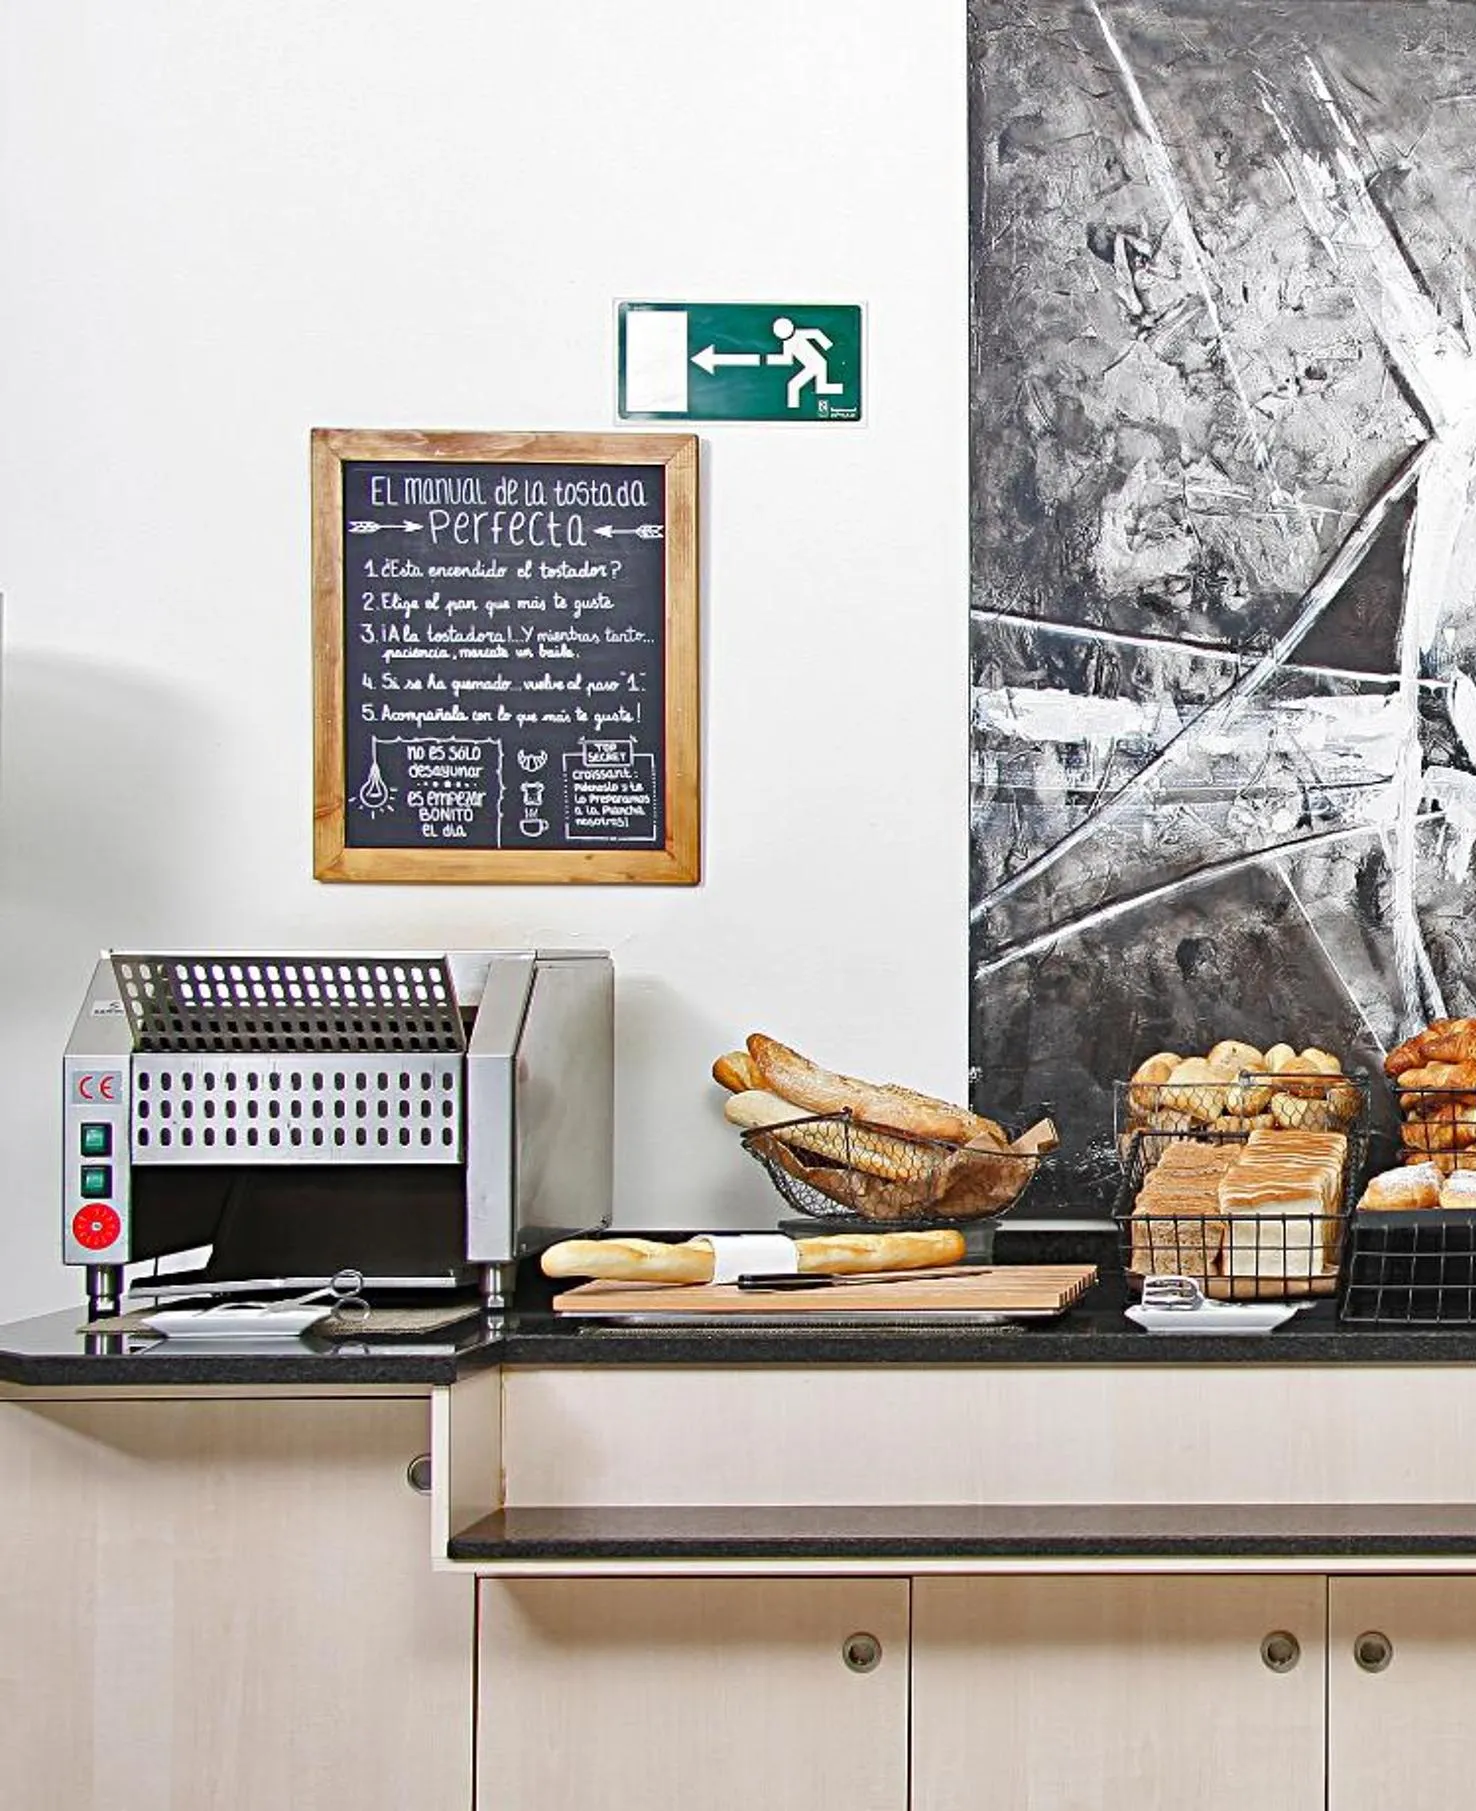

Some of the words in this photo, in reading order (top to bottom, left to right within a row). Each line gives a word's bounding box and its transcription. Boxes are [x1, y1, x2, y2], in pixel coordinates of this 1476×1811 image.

[495, 477, 519, 505] de
[554, 479, 648, 506] tostada
[429, 509, 587, 547] Perfecta
[428, 559, 507, 578] encendido
[517, 559, 533, 579] el
[381, 592, 419, 619] Elige
[425, 592, 440, 610] el
[444, 599, 478, 617] pan
[485, 599, 510, 619] que
[552, 592, 568, 609] te
[573, 592, 615, 619] guste
[403, 623, 420, 642] la
[537, 625, 600, 644] mientras
[403, 678, 422, 690] se
[427, 672, 447, 690] ha
[523, 672, 565, 691] vuelve
[566, 672, 582, 690] al
[586, 680, 619, 698] paso
[381, 703, 469, 728] Acompañala
[472, 710, 493, 721] con
[498, 703, 513, 721] lo
[515, 712, 538, 729] que
[574, 706, 589, 722] te
[593, 743, 618, 753] TOP
[408, 763, 484, 779] desayunar
[419, 806, 474, 822] BONITO
